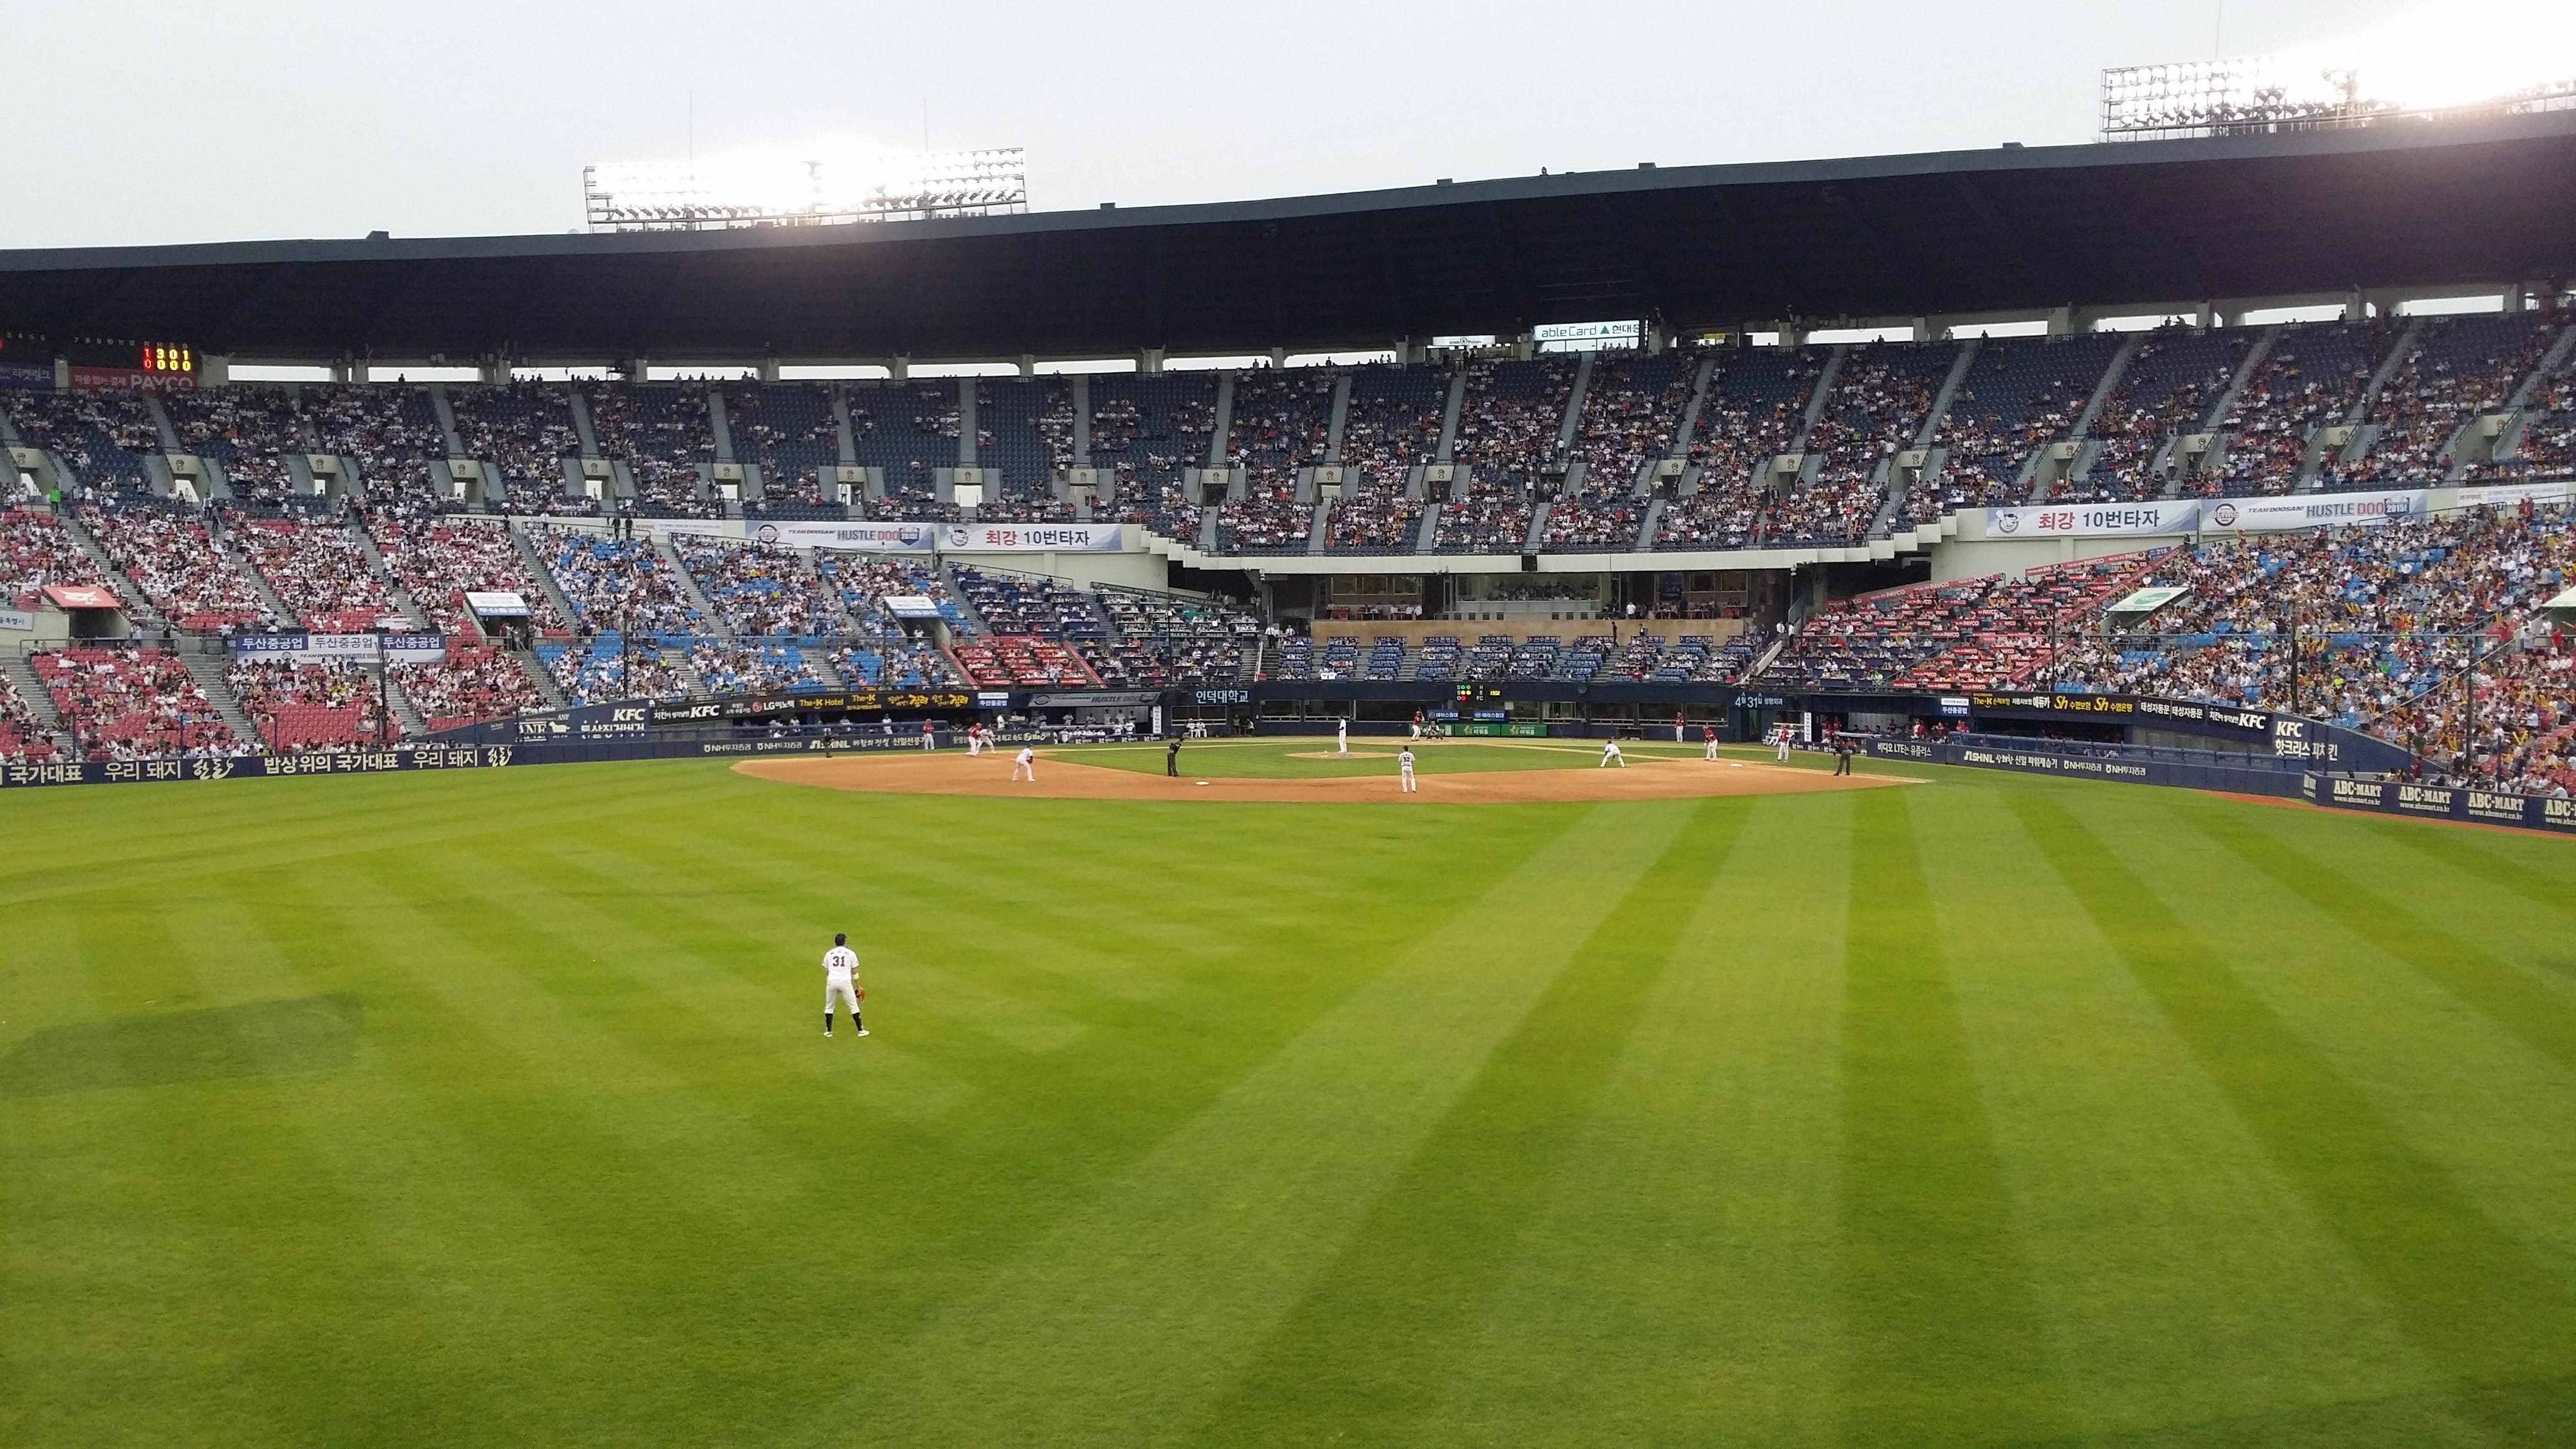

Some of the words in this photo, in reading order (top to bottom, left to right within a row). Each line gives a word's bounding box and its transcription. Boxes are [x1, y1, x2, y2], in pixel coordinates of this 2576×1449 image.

[144, 348, 150, 358] 1
[157, 348, 165, 359] 3
[170, 349, 178, 359] 0
[183, 350, 188, 360] 1
[144, 359, 152, 369] 0
[157, 359, 165, 369] 0
[170, 360, 178, 370] 0
[182, 360, 191, 371] 0
[131, 374, 192, 389] PAYCO
[2306, 502, 2355, 517] HUSTLE
[2356, 502, 2383, 516] DOO
[2386, 503, 2408, 512] 2015!
[2039, 511, 2076, 530] 최강
[2083, 509, 2159, 528] 10번타자
[837, 530, 876, 540] HUSTLE
[877, 530, 900, 541] DOO
[985, 530, 1017, 546] 최강
[1023, 530, 1090, 545] 10번타자
[243, 638, 303, 650] 두산중공업
[315, 637, 373, 650] 두산중공업
[383, 637, 440, 649] 두산중공업
[1092, 695, 1121, 703] HUSTLE
[1196, 690, 1249, 704] 인덕대학교
[2033, 696, 2051, 709] 에듀카
[763, 700, 795, 711] LG이노텍
[2054, 695, 2068, 710] Sh
[2069, 702, 2091, 711] 수협보험
[2094, 697, 2109, 711] Sh
[2110, 703, 2133, 713] 수협은행
[2140, 701, 2170, 715] 태성자동문
[2172, 704, 2203, 719] 태성자동문
[612, 708, 646, 721] KFC
[690, 705, 721, 718] KFC
[2238, 713, 2267, 729] KFC
[2275, 721, 2303, 737] KFC
[711, 744, 751, 752] NH투자증권
[764, 741, 803, 750] NH투자증권
[1878, 743, 1893, 753] 비디오
[1895, 743, 1910, 756] LTE는
[1910, 744, 1933, 758] 유플러스
[265, 756, 297, 774] 밥상
[300, 754, 331, 773] 위의
[336, 753, 399, 771] 국가대표
[413, 751, 444, 768] 우리
[447, 750, 478, 768] 돼지
[2015, 755, 2027, 766] 신일
[2028, 756, 2058, 769] 파워제습기
[104, 761, 140, 781] 우리
[146, 760, 181, 779] 돼지
[2070, 761, 2102, 771] NH투자증권
[2112, 764, 2146, 776] NH투자증권
[9, 764, 84, 784] 국가대표
[2334, 780, 2383, 798] ABC-MART
[2399, 786, 2452, 804] ABC-MART
[2334, 796, 2381, 806] www.abcmart.co.kr
[2399, 802, 2451, 813] www.abcmart.co.kr
[2468, 792, 2525, 811] ABC-MART
[2469, 809, 2523, 821] www.abcmart.co.kr
[832, 955, 846, 967] 31
